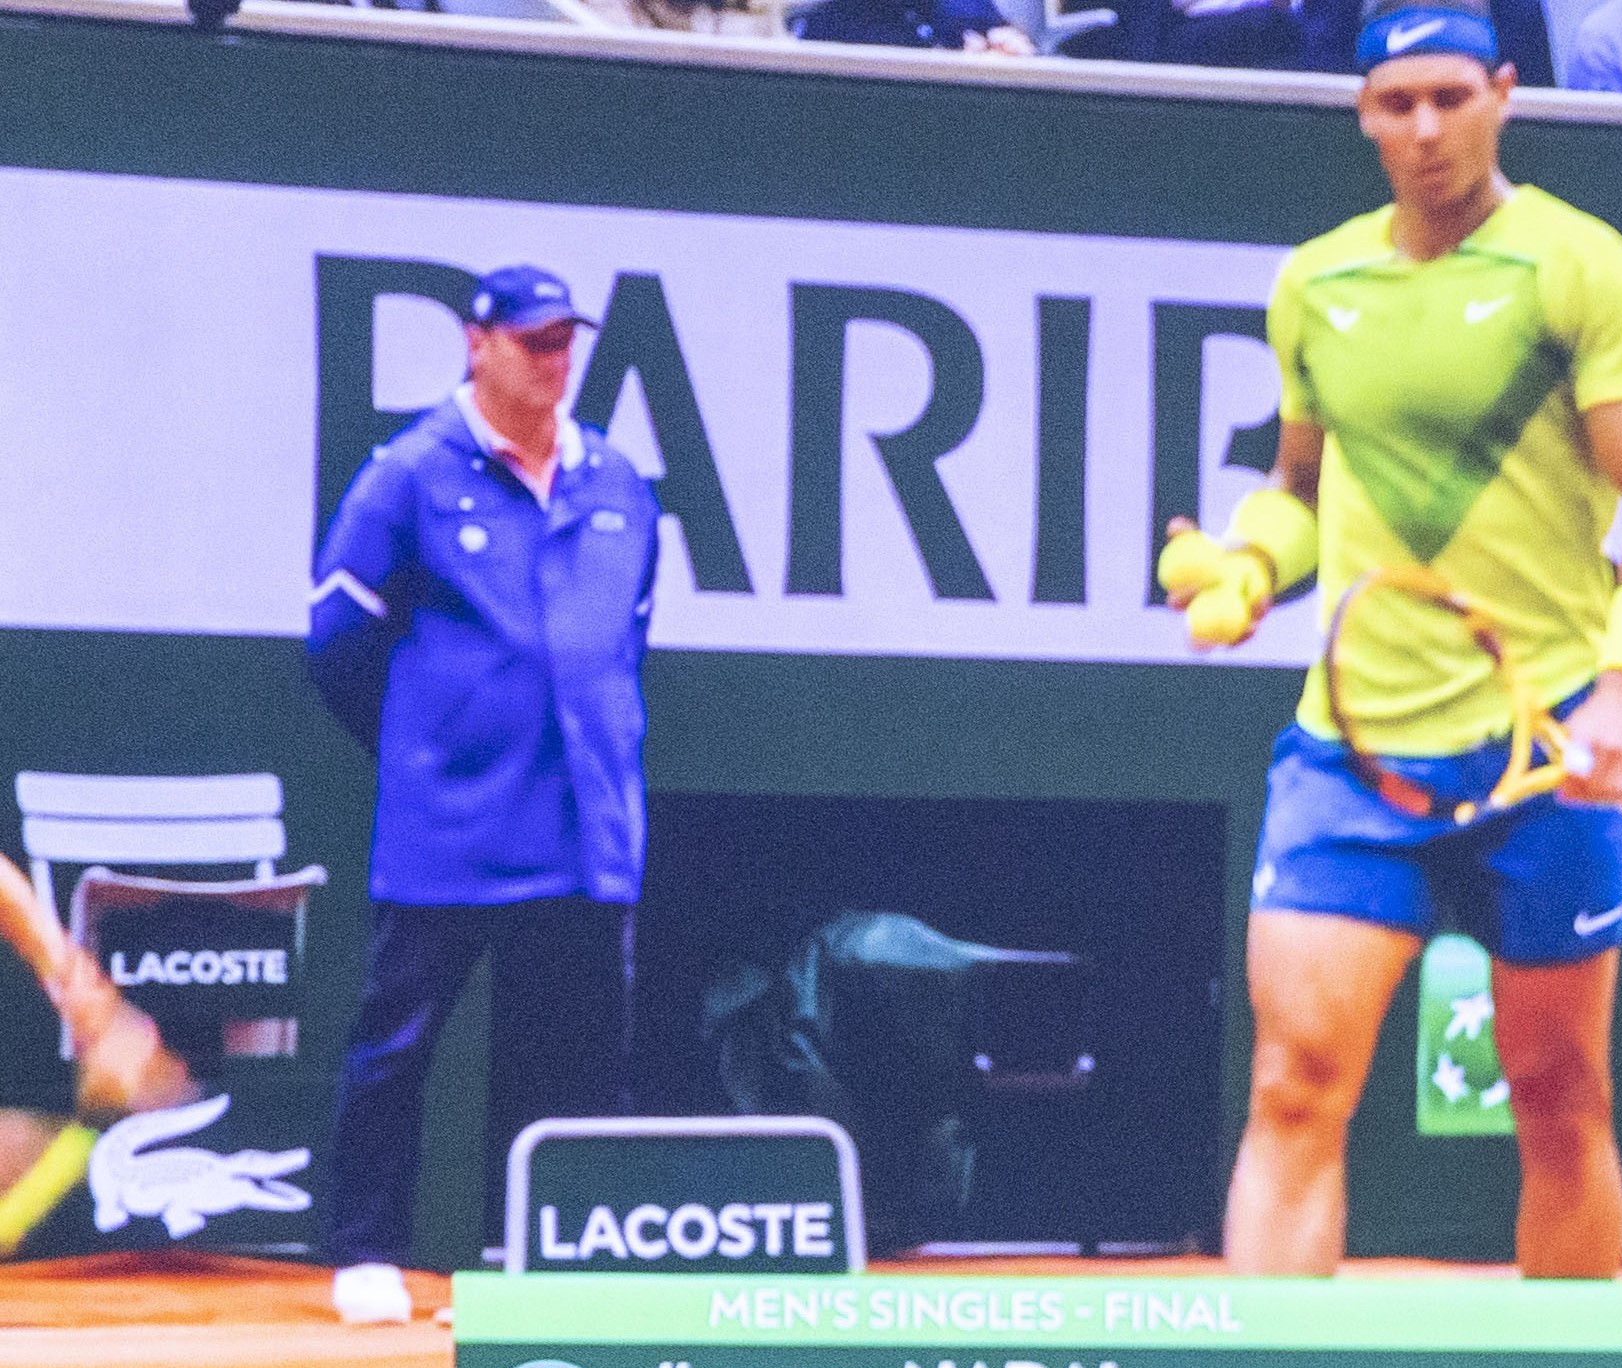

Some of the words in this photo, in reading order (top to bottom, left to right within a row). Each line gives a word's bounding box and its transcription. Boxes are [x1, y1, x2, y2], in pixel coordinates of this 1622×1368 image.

[111, 948, 288, 987] LACOSTE
[538, 1203, 834, 1261] LACOSTE
[708, 1288, 859, 1331] MEN'S
[868, 1289, 1065, 1332] SINGLES
[1103, 1292, 1243, 1334] FINAL
